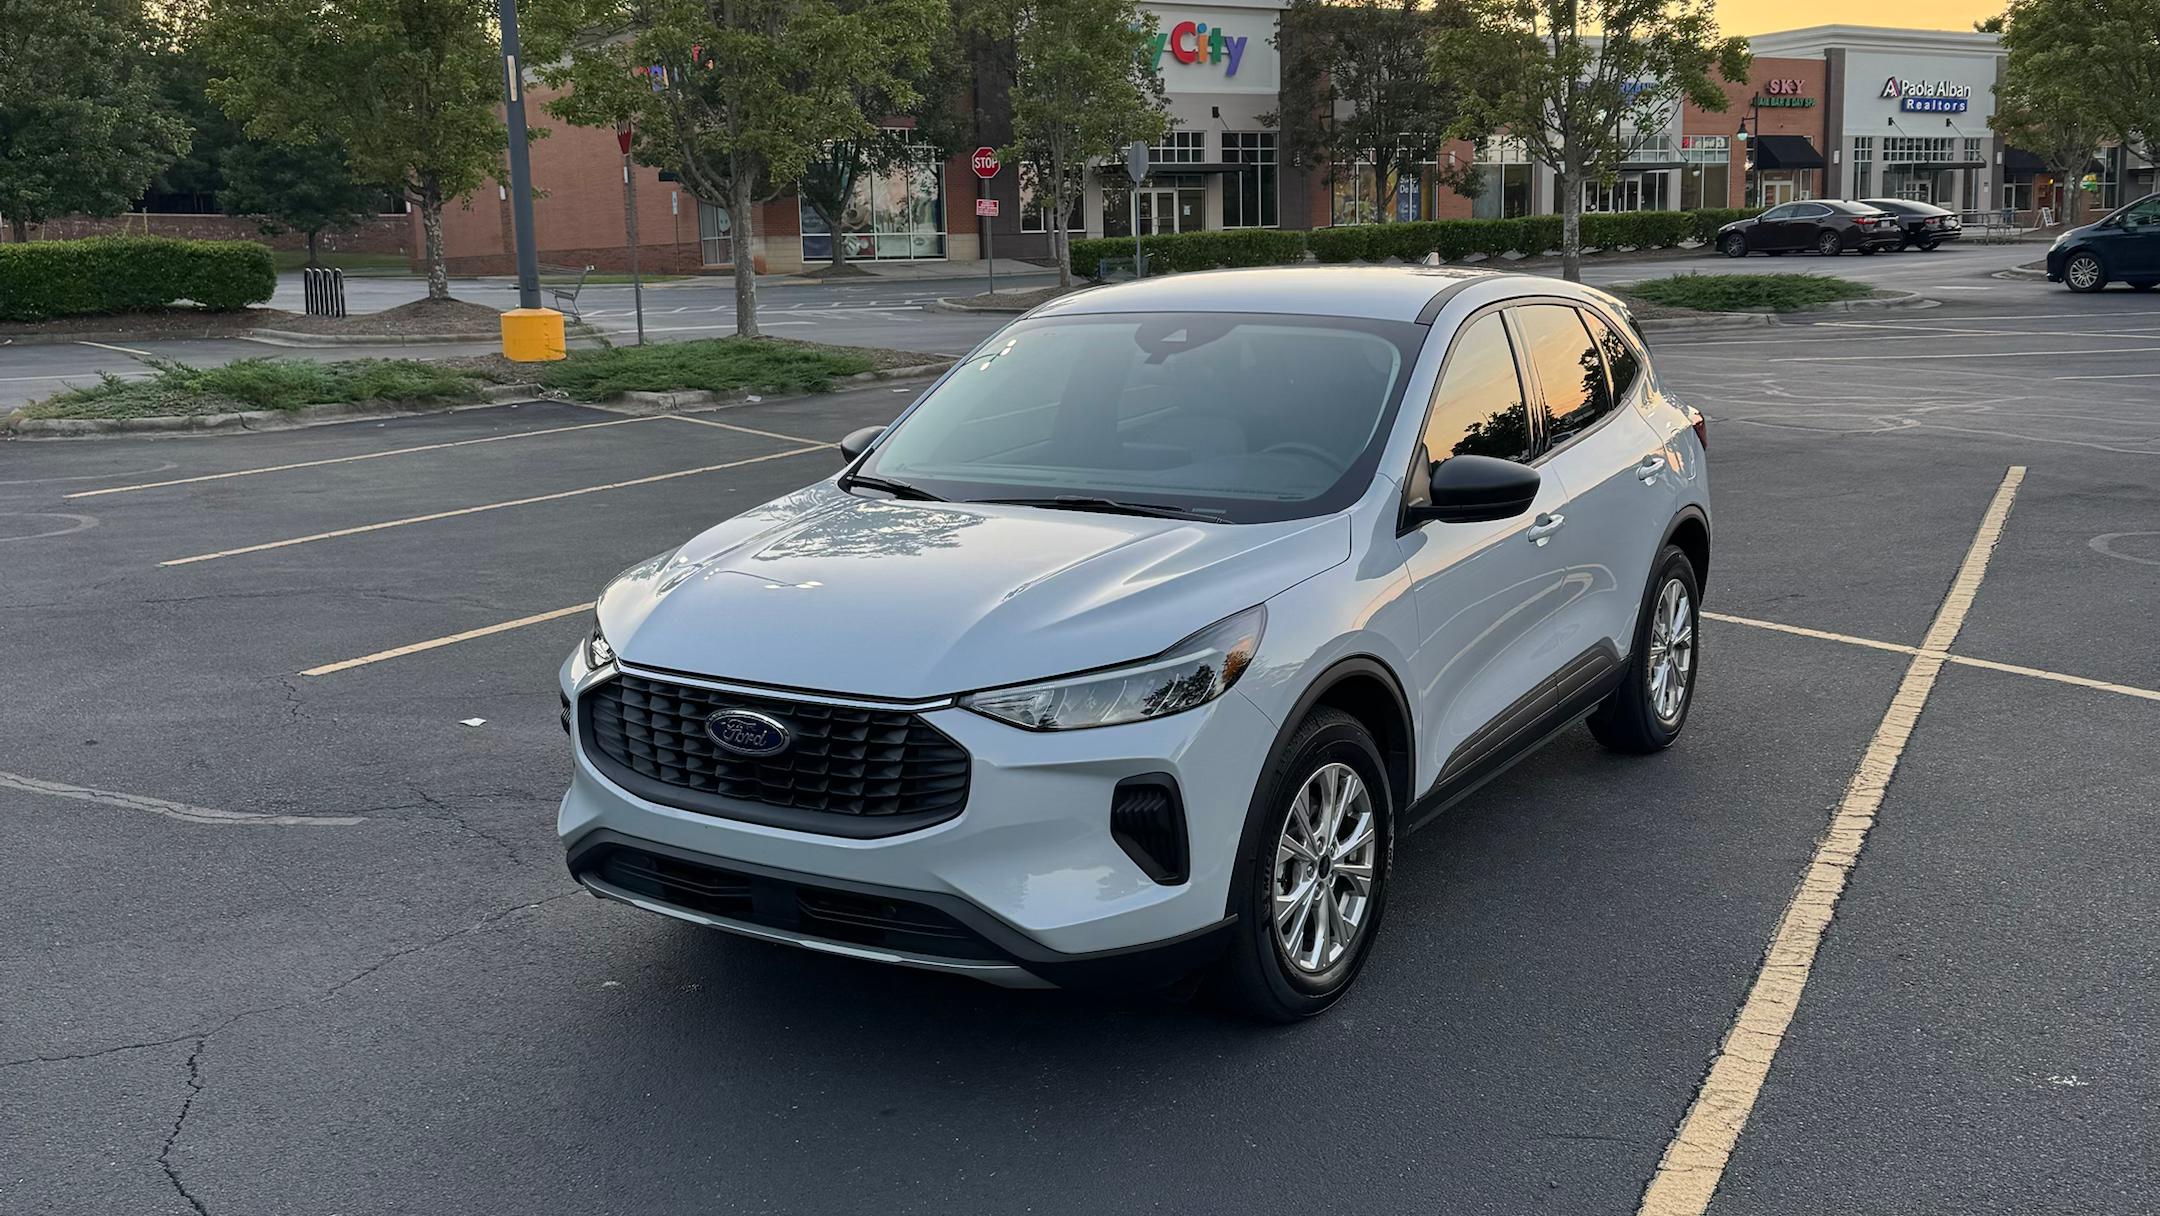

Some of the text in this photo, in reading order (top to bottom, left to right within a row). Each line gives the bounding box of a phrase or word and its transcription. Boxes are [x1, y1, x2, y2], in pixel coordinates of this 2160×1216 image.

[1171, 21, 1248, 77] City
[1769, 79, 1806, 94] SKY
[1901, 80, 1971, 97] Paola Alban
[1906, 99, 1966, 111] Realtors
[974, 156, 998, 169] STOP
[721, 718, 768, 747] Ford
